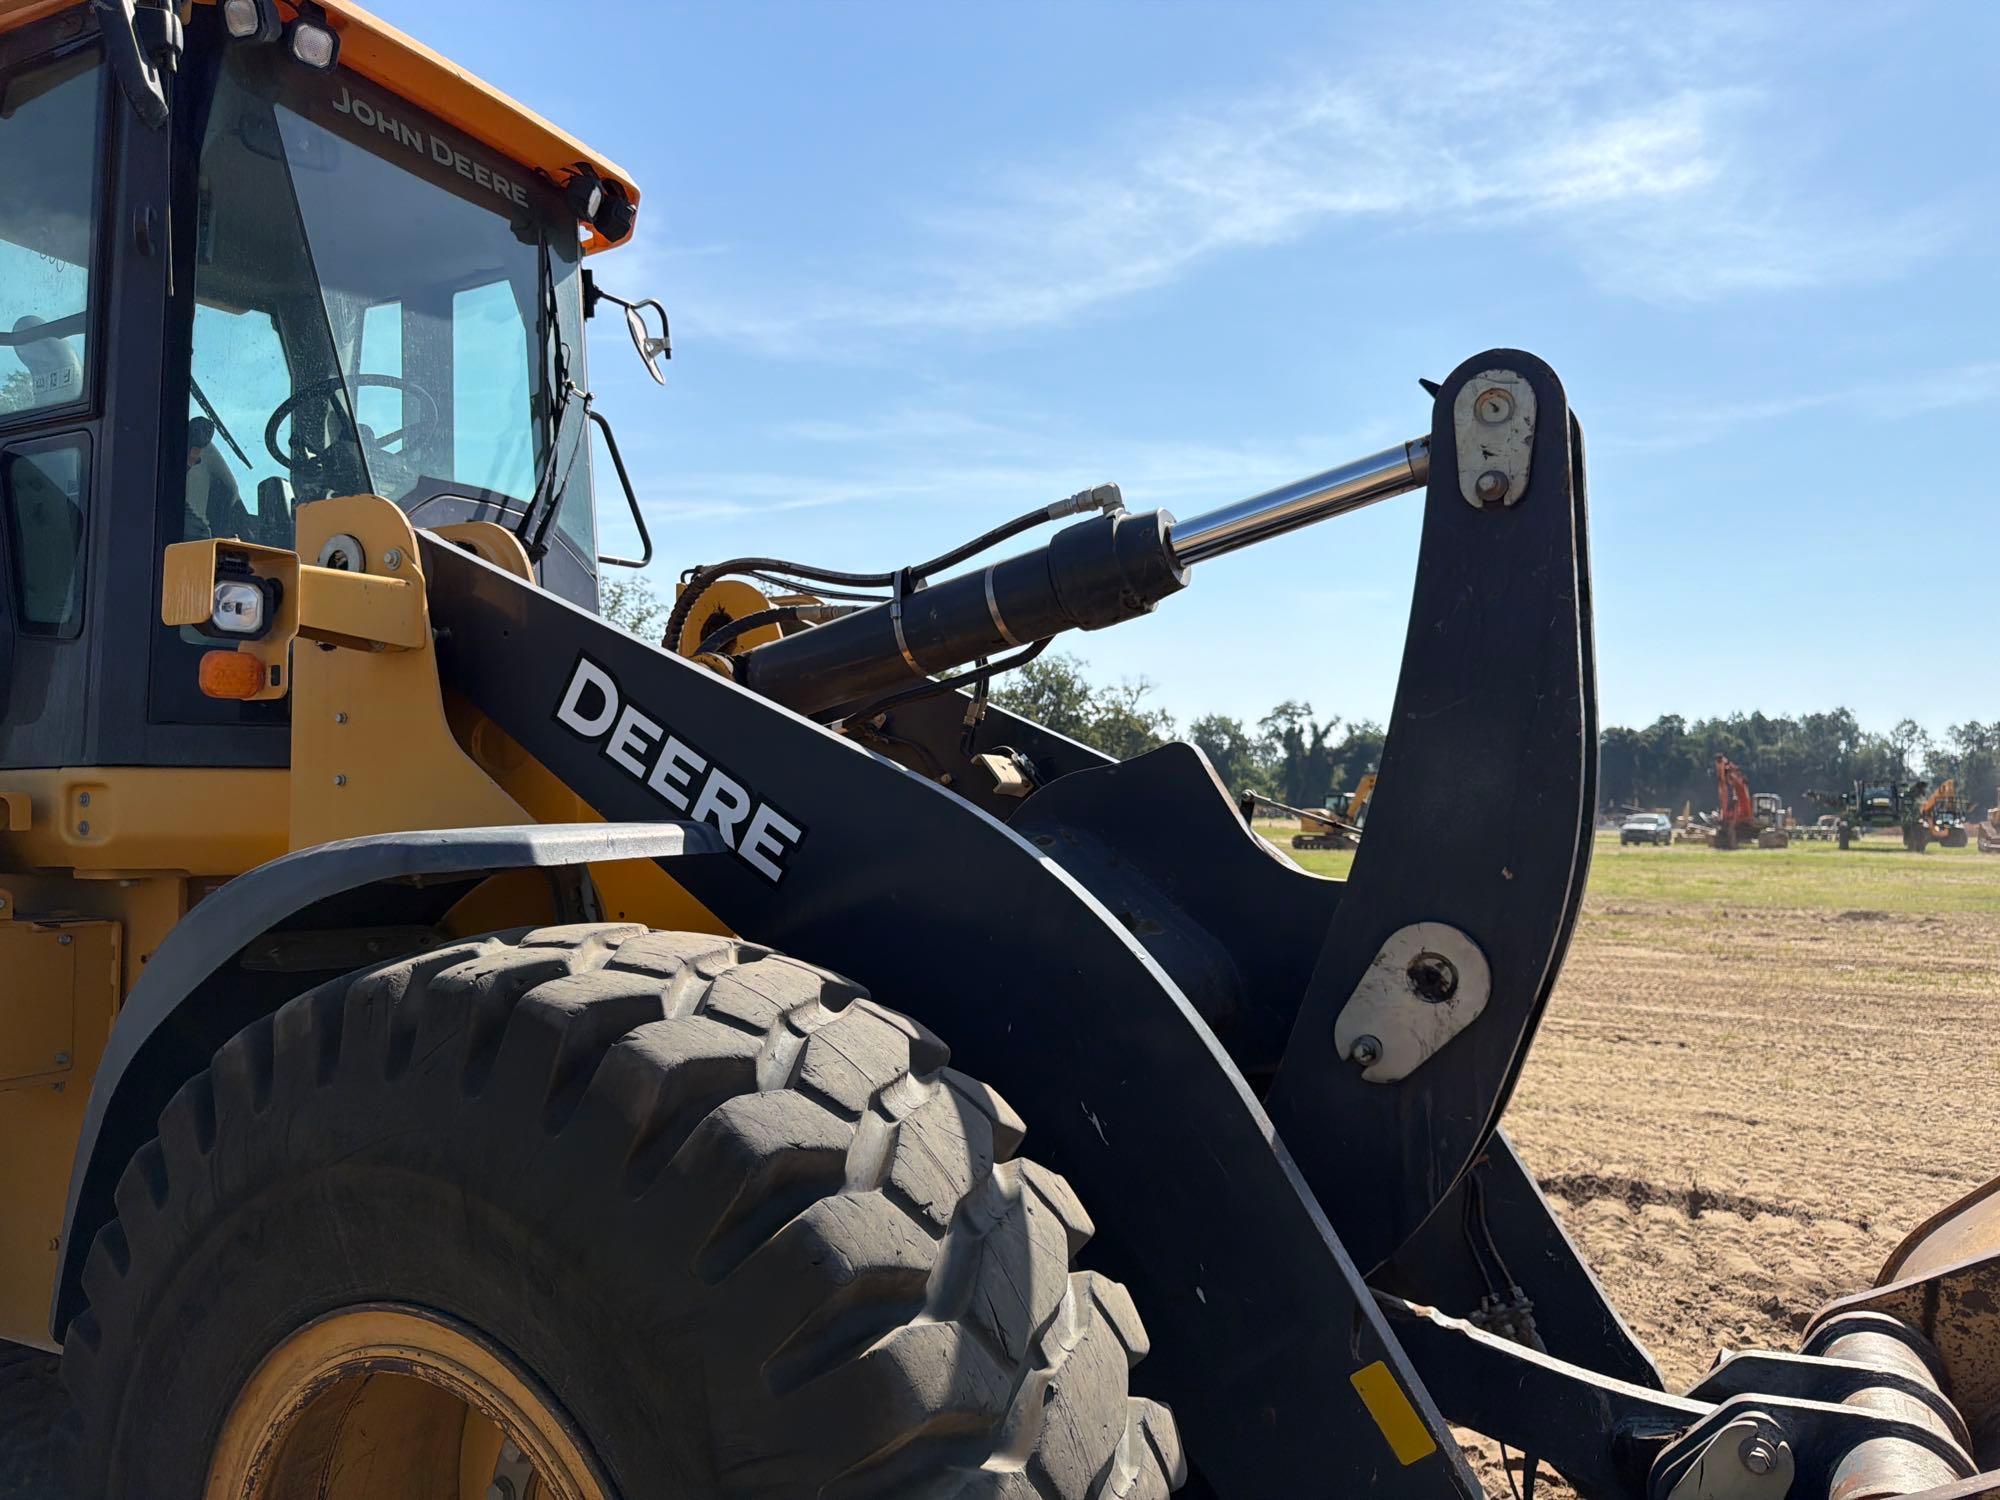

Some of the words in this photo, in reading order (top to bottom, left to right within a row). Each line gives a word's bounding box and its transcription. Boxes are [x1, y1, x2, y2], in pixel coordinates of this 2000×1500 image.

[332, 88, 424, 153] JOHN
[429, 133, 529, 208] DEERE
[557, 657, 802, 883] DEERE
